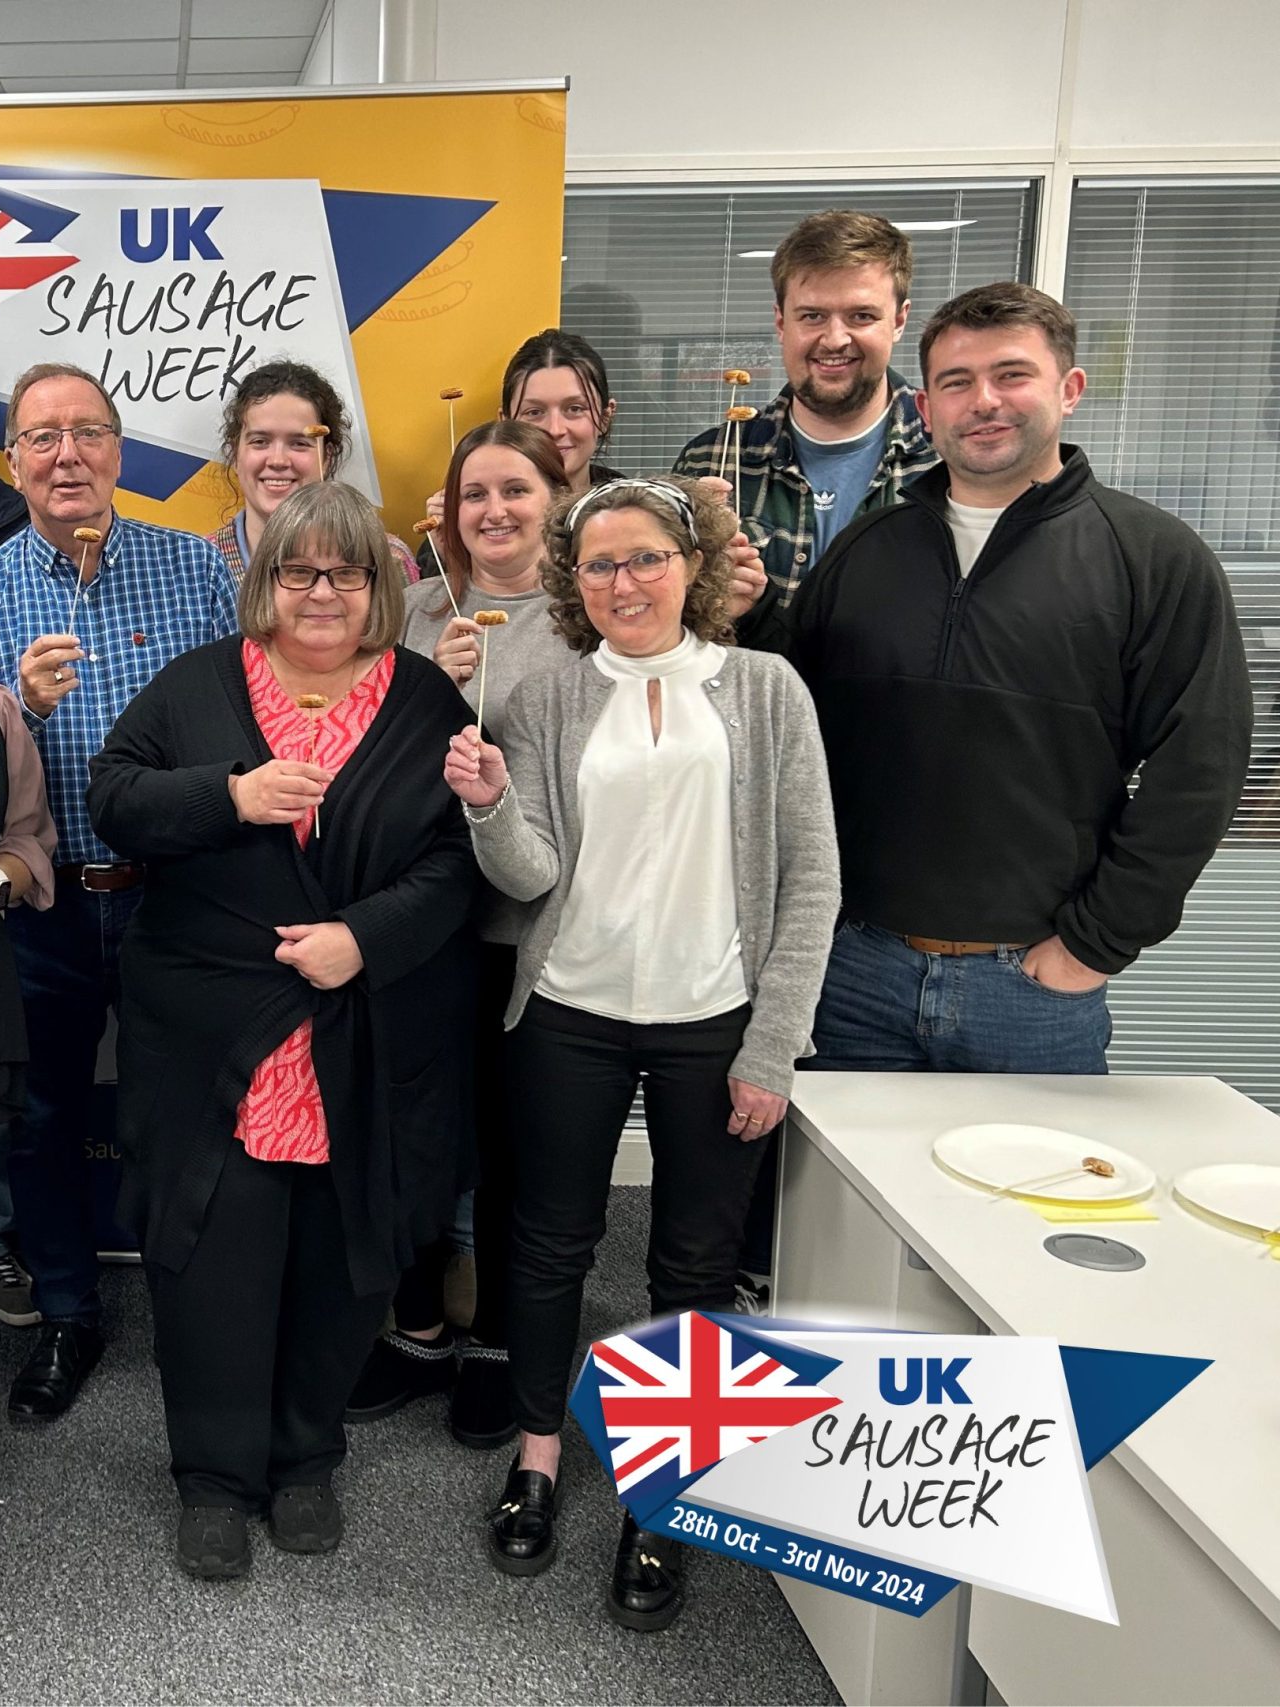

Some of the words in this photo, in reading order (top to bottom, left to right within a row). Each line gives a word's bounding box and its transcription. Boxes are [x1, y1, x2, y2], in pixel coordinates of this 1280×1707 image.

[120, 206, 225, 264] UK
[39, 269, 317, 345] SAUSAGE
[100, 334, 257, 402] WEEK
